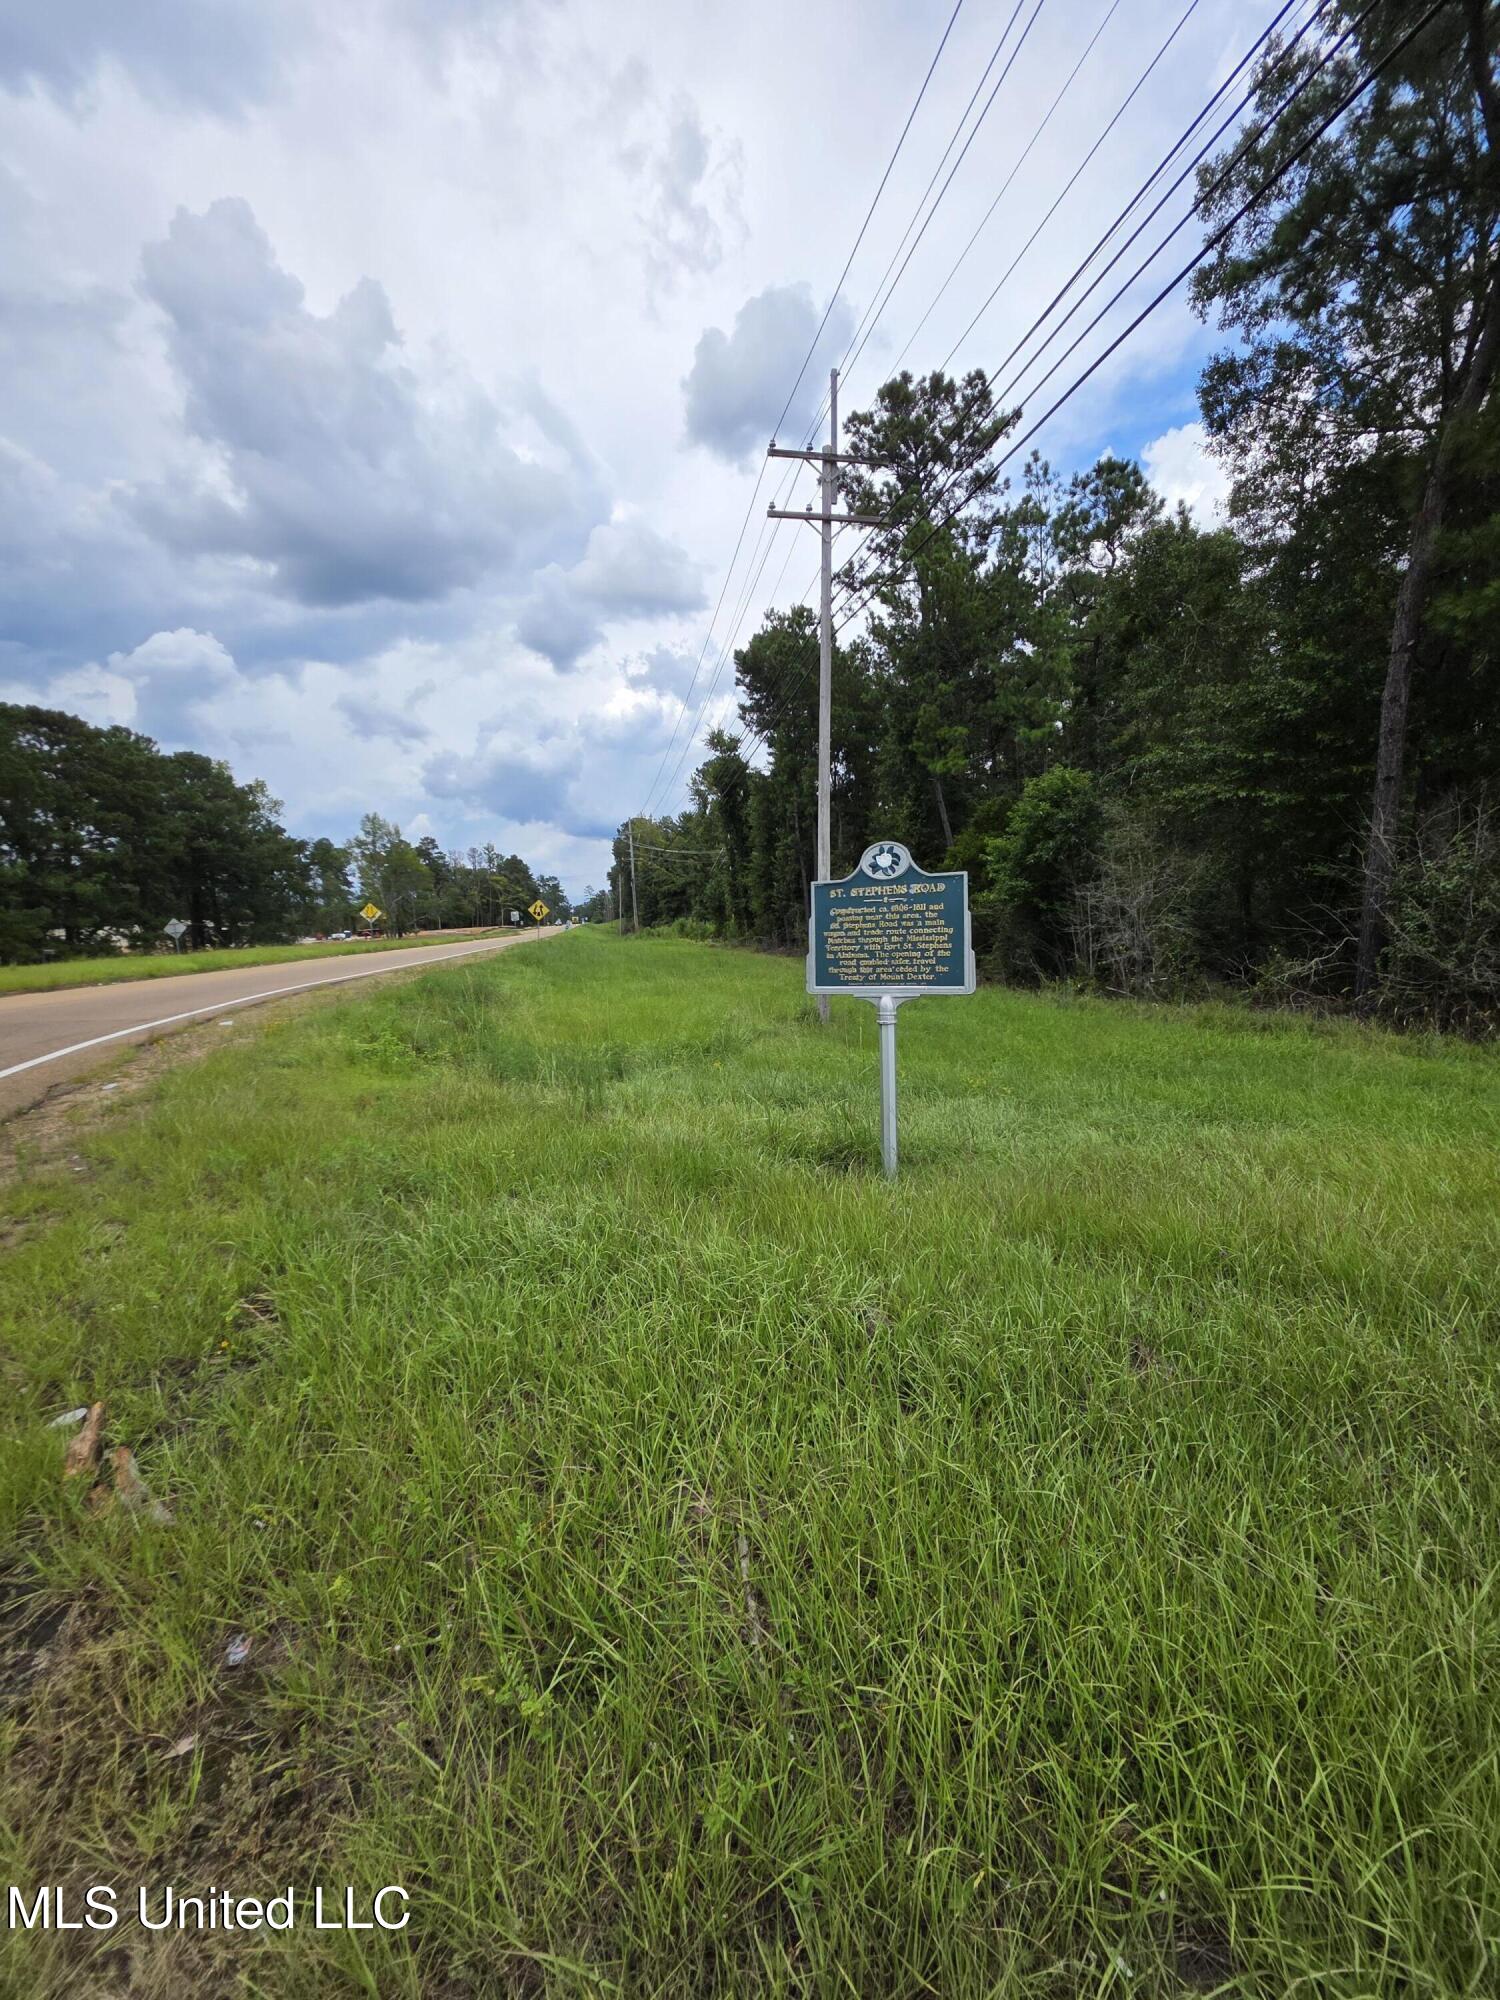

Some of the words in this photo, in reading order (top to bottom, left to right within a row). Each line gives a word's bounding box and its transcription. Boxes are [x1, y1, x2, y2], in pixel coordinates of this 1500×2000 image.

[830, 889, 846, 898] ST.
[850, 885, 907, 897] STEPHENS
[909, 883, 945, 894] ROAD
[929, 902, 944, 910] and
[843, 921, 876, 930] Stephens
[909, 926, 954, 934] connecting
[857, 936, 888, 944] through
[906, 934, 948, 943] Mississippi
[883, 942, 901, 950] Fort
[916, 941, 953, 950] Stephens
[891, 950, 921, 958] opening
[937, 949, 951, 957] the
[839, 958, 857, 966] road
[912, 956, 936, 965] travel
[828, 966, 857, 974] through
[895, 965, 918, 973] ceded
[920, 964, 931, 974] by
[839, 973, 866, 982] Treaty
[880, 972, 904, 980] Mount
[907, 972, 937, 980] Dexter.
